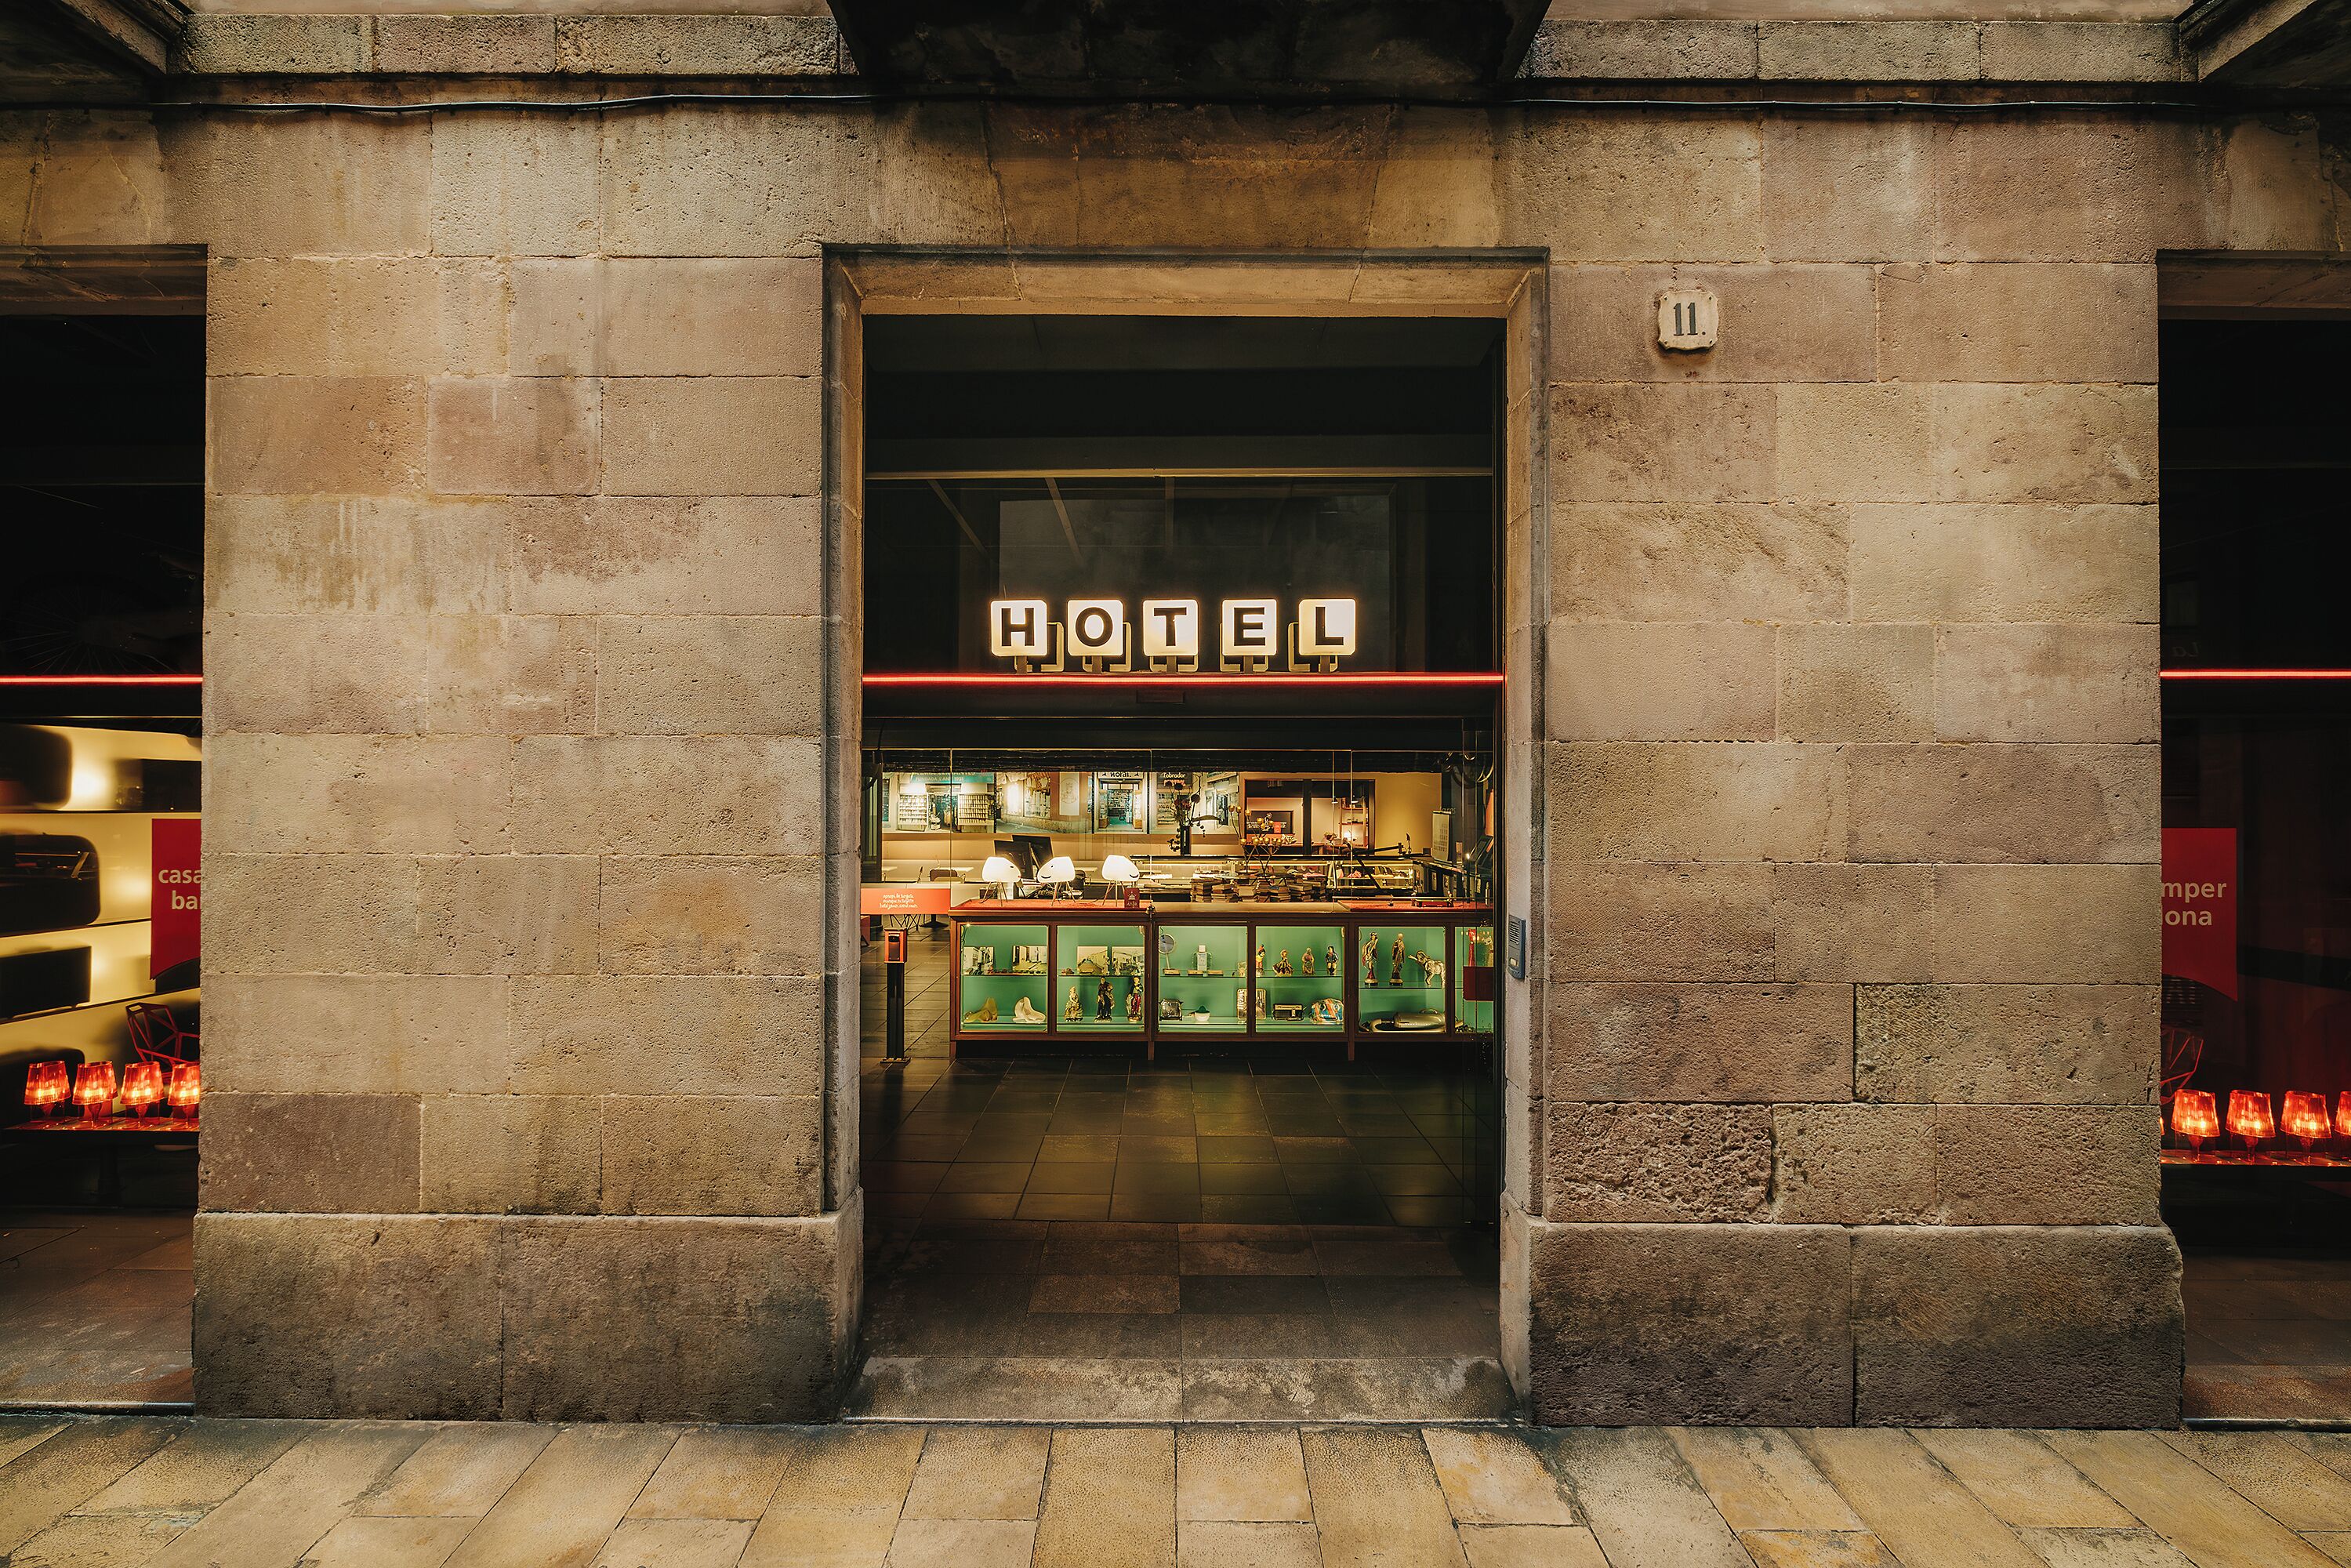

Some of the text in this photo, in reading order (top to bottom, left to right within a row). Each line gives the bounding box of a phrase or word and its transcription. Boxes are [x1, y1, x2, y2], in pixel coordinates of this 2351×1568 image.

[1001, 606, 1344, 648] HOTEL
[158, 869, 201, 884] casa
[172, 890, 201, 909] ba
[2161, 883, 2226, 903] mper
[2161, 910, 2212, 925] ona
